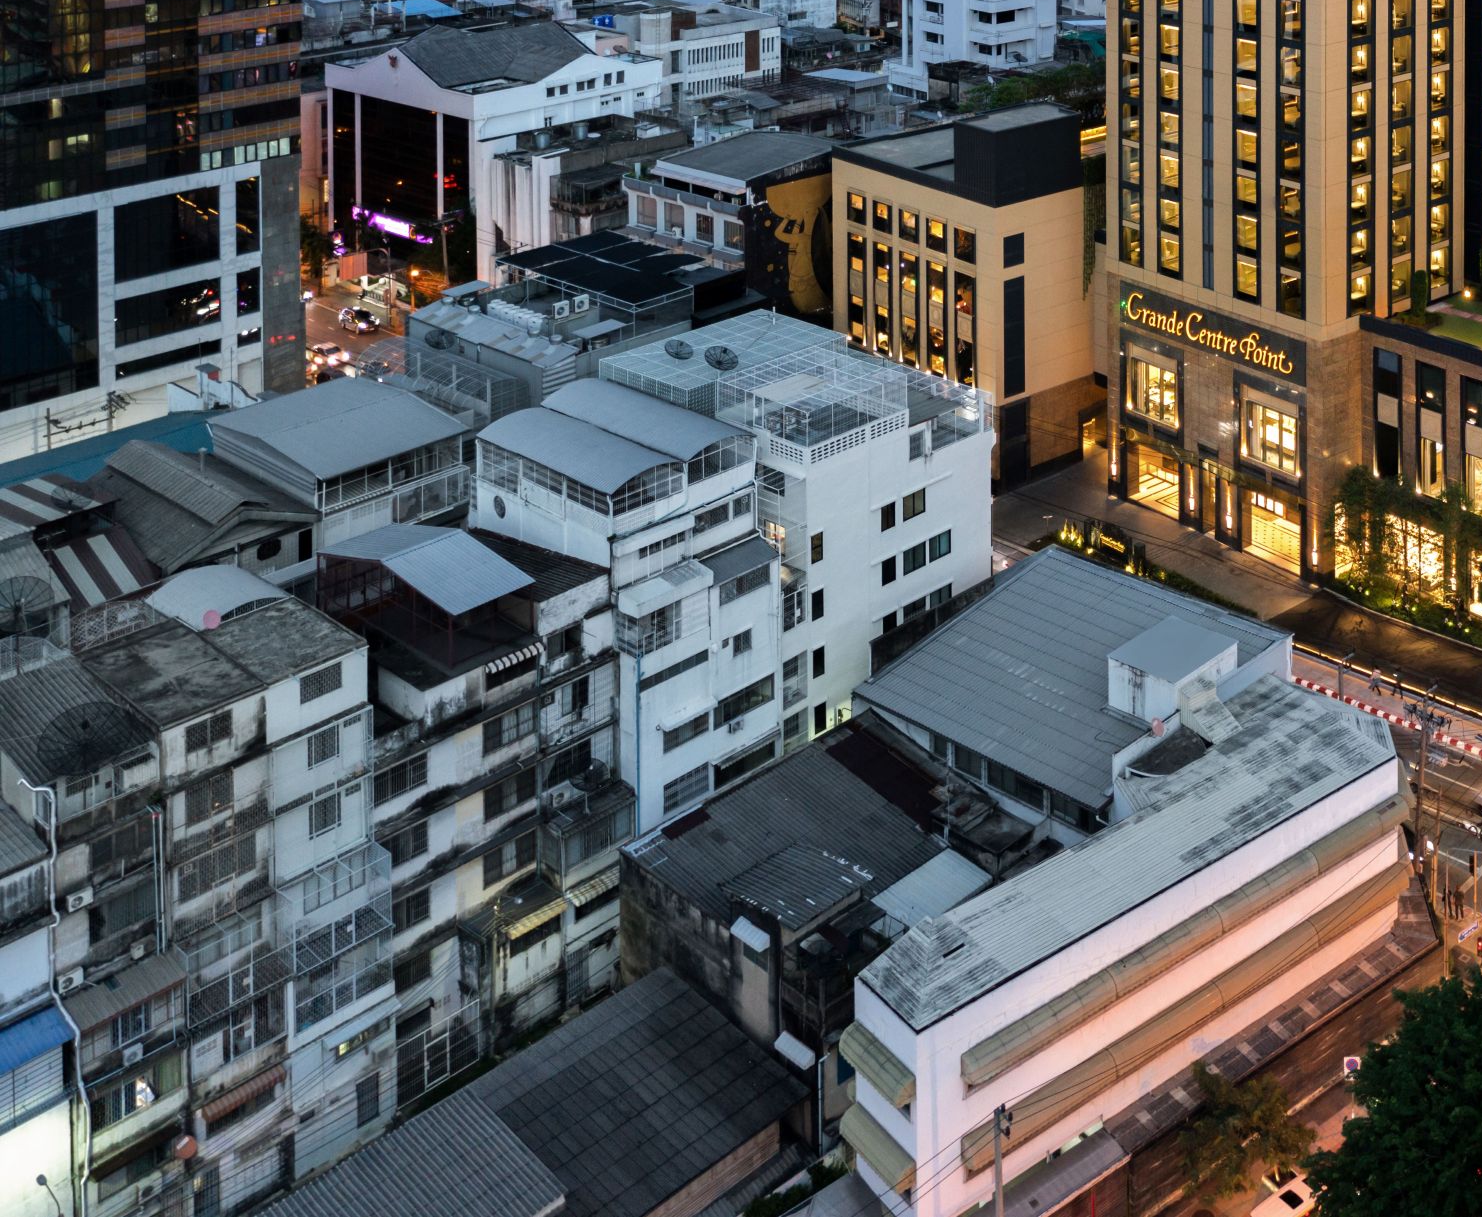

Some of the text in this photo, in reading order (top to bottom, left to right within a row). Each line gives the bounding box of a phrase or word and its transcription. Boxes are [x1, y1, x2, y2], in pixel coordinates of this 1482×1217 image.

[1127, 292, 1293, 374] Grande Centre Point
